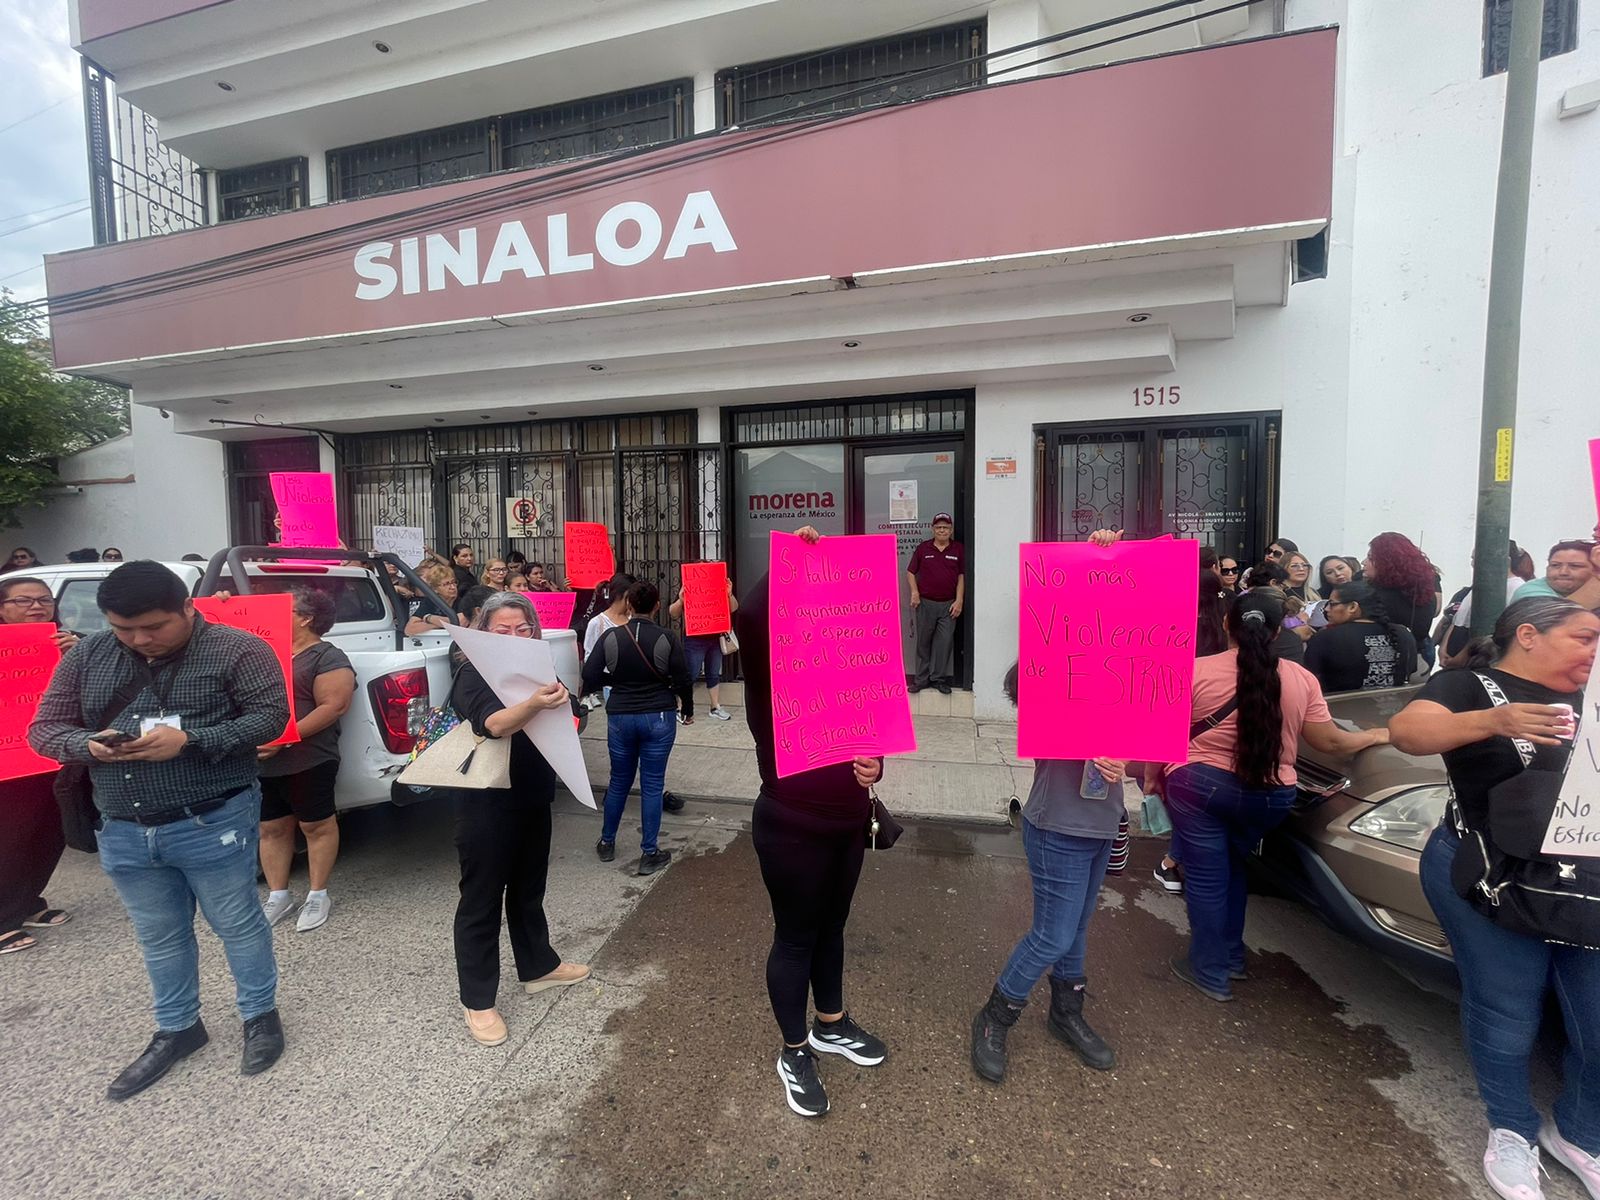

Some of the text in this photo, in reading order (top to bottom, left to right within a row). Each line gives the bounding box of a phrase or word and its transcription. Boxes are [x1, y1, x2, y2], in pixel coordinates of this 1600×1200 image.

[354, 190, 738, 300] SINALOA
[1132, 386, 1181, 406] 1515
[749, 491, 835, 511] morena
[750, 508, 836, 520] La esperanza de México
[849, 567, 872, 582] en
[1025, 554, 1066, 588] No
[795, 595, 892, 626] ayuntamiento
[822, 624, 864, 642] espera
[1027, 602, 1192, 650] Violencia
[837, 644, 889, 670] Senado
[1025, 657, 1048, 678] de
[808, 688, 827, 714] al
